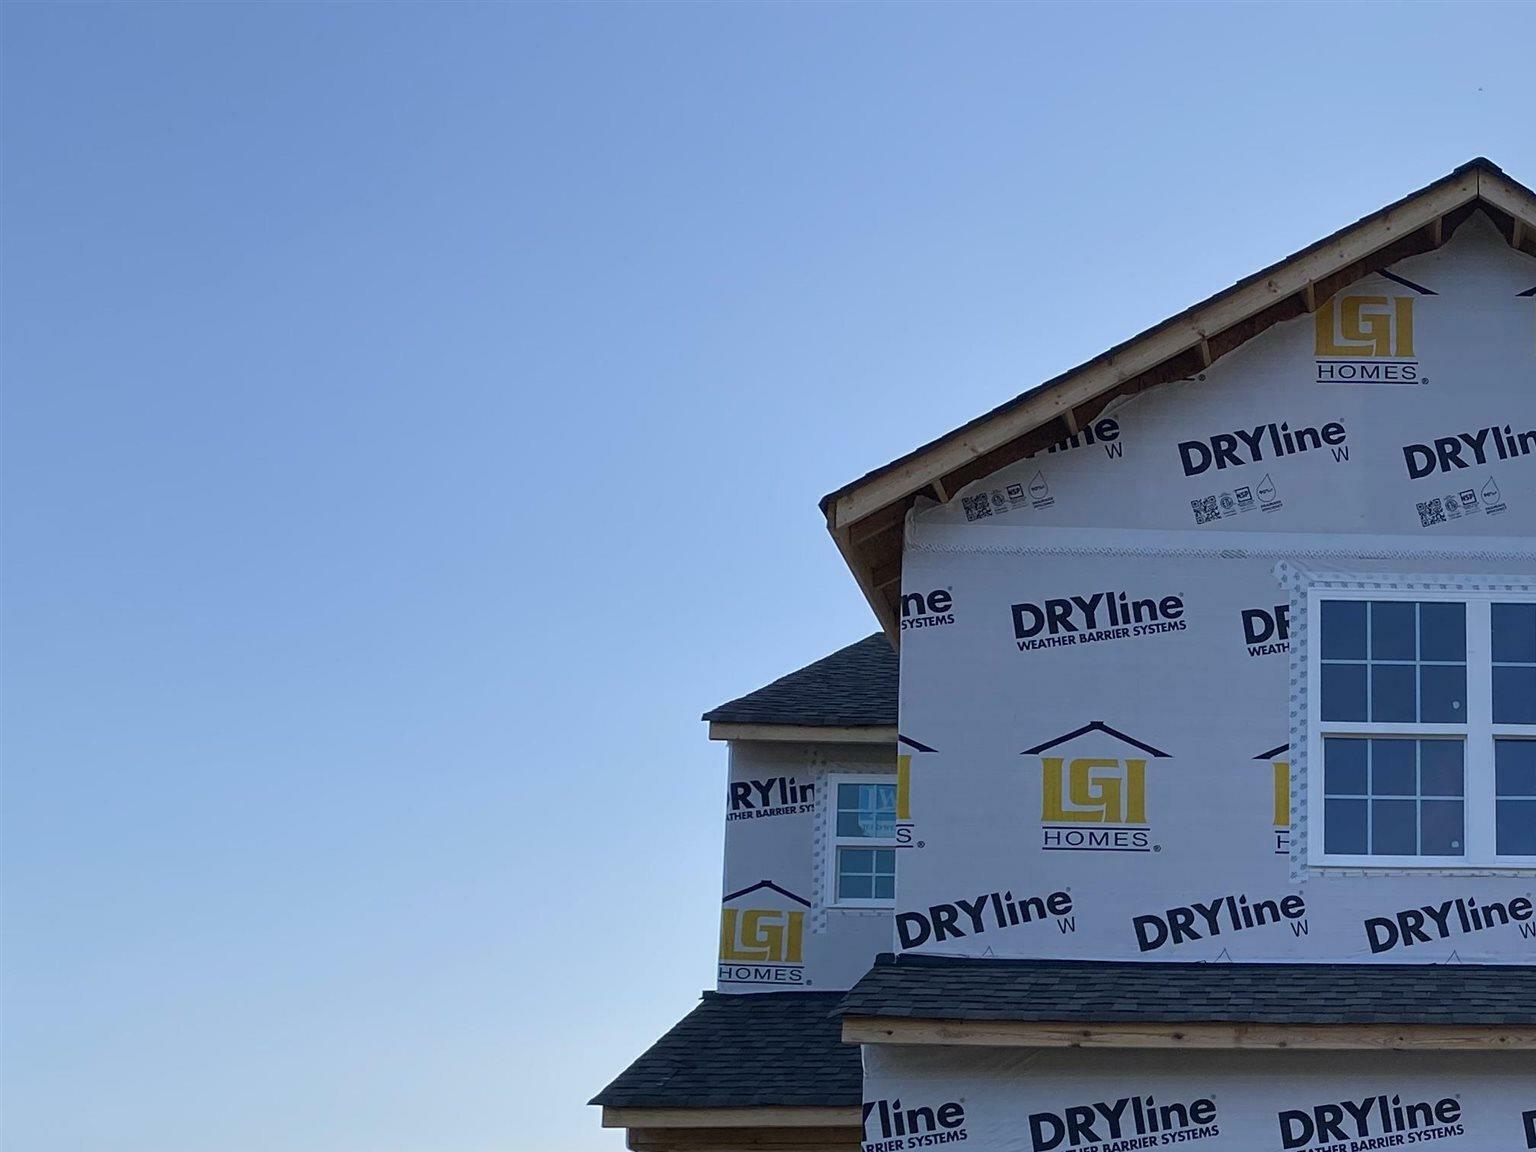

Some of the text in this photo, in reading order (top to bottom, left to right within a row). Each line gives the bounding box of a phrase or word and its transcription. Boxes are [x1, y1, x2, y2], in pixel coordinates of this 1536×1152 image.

[1313, 296, 1416, 358] LGI
[1317, 364, 1417, 381] HOMES
[1178, 420, 1346, 476] DRYline
[1011, 592, 1184, 641] DRYline
[1016, 620, 1187, 652] WEATHER BARRIER SYSTEMS
[756, 806, 797, 818] BARRIER
[1041, 757, 1147, 824] LGI
[1044, 830, 1149, 847] HOMES
[720, 908, 804, 963] LGI
[896, 891, 1072, 949] DRYline
[1133, 894, 1305, 952] DRYline
[1364, 898, 1533, 954] DRYline
[720, 967, 803, 981] HOMES
[908, 1128, 967, 1149] SYSTEMS
[1029, 1096, 1216, 1152] DRYline
[1160, 1126, 1219, 1146] SYSTEMS
[1278, 1095, 1461, 1150] DRYline
[1350, 1134, 1404, 1152] BARRIER
[1407, 1124, 1464, 1144] SYSTEMS
